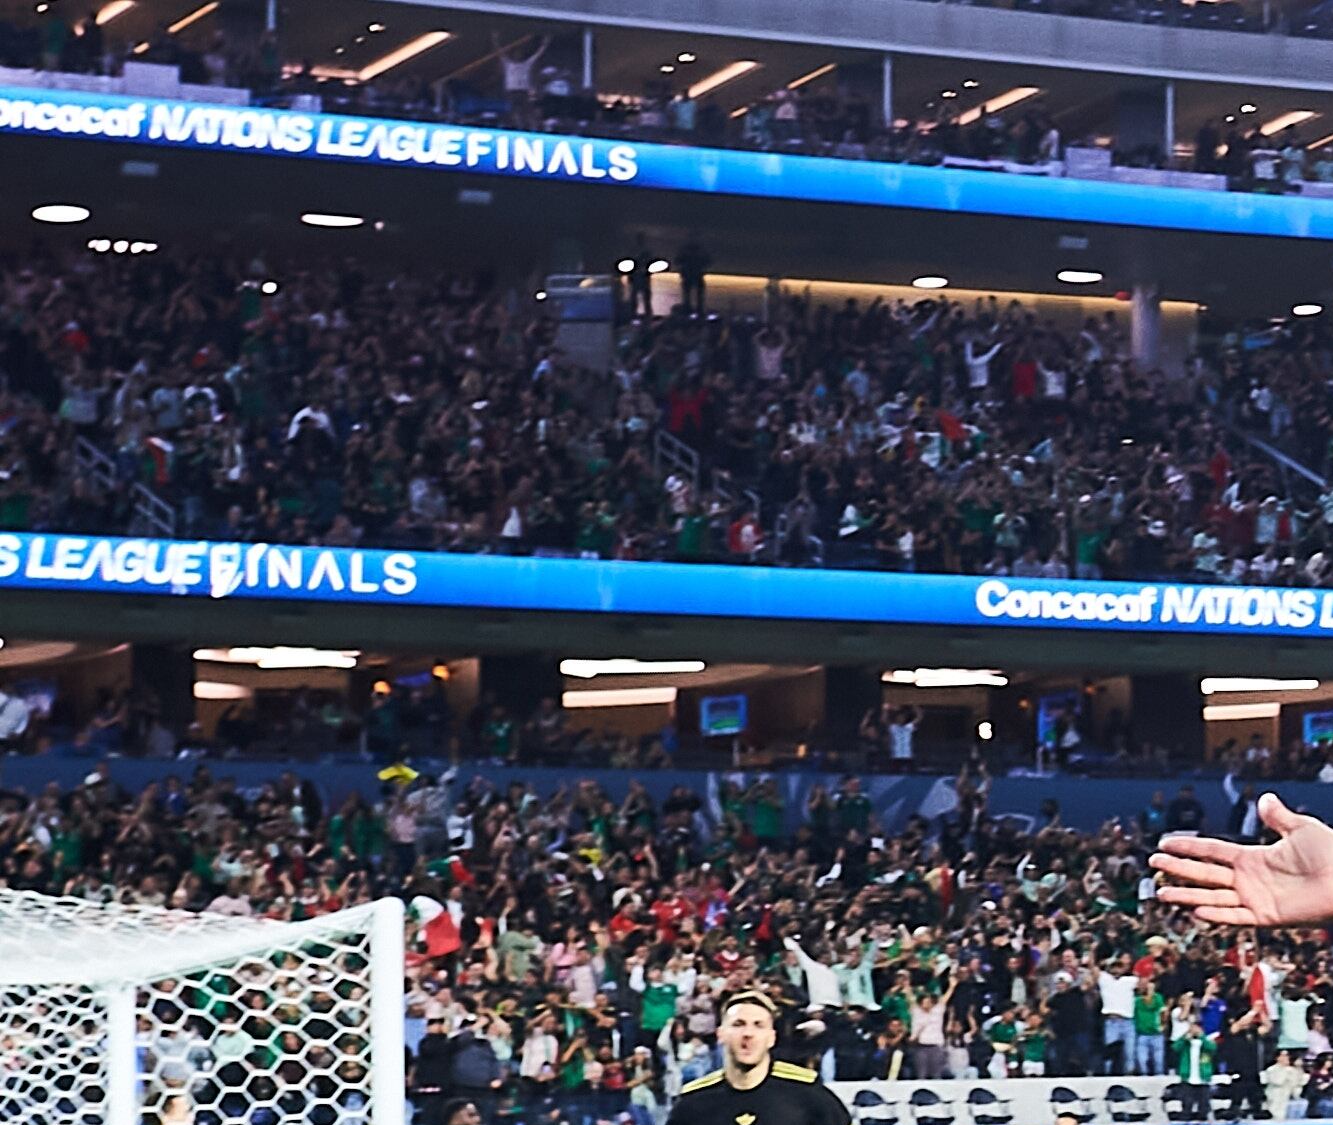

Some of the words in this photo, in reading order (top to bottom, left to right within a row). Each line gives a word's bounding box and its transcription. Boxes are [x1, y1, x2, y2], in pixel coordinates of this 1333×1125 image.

[0, 97, 146, 137] oncacaf
[148, 105, 315, 152] NATIONS
[316, 119, 465, 165] LEAGUE
[466, 131, 638, 181] FINALS
[25, 535, 208, 586] LEAGUE
[975, 579, 1158, 623] Concacaf
[1160, 586, 1316, 628] NATIONS
